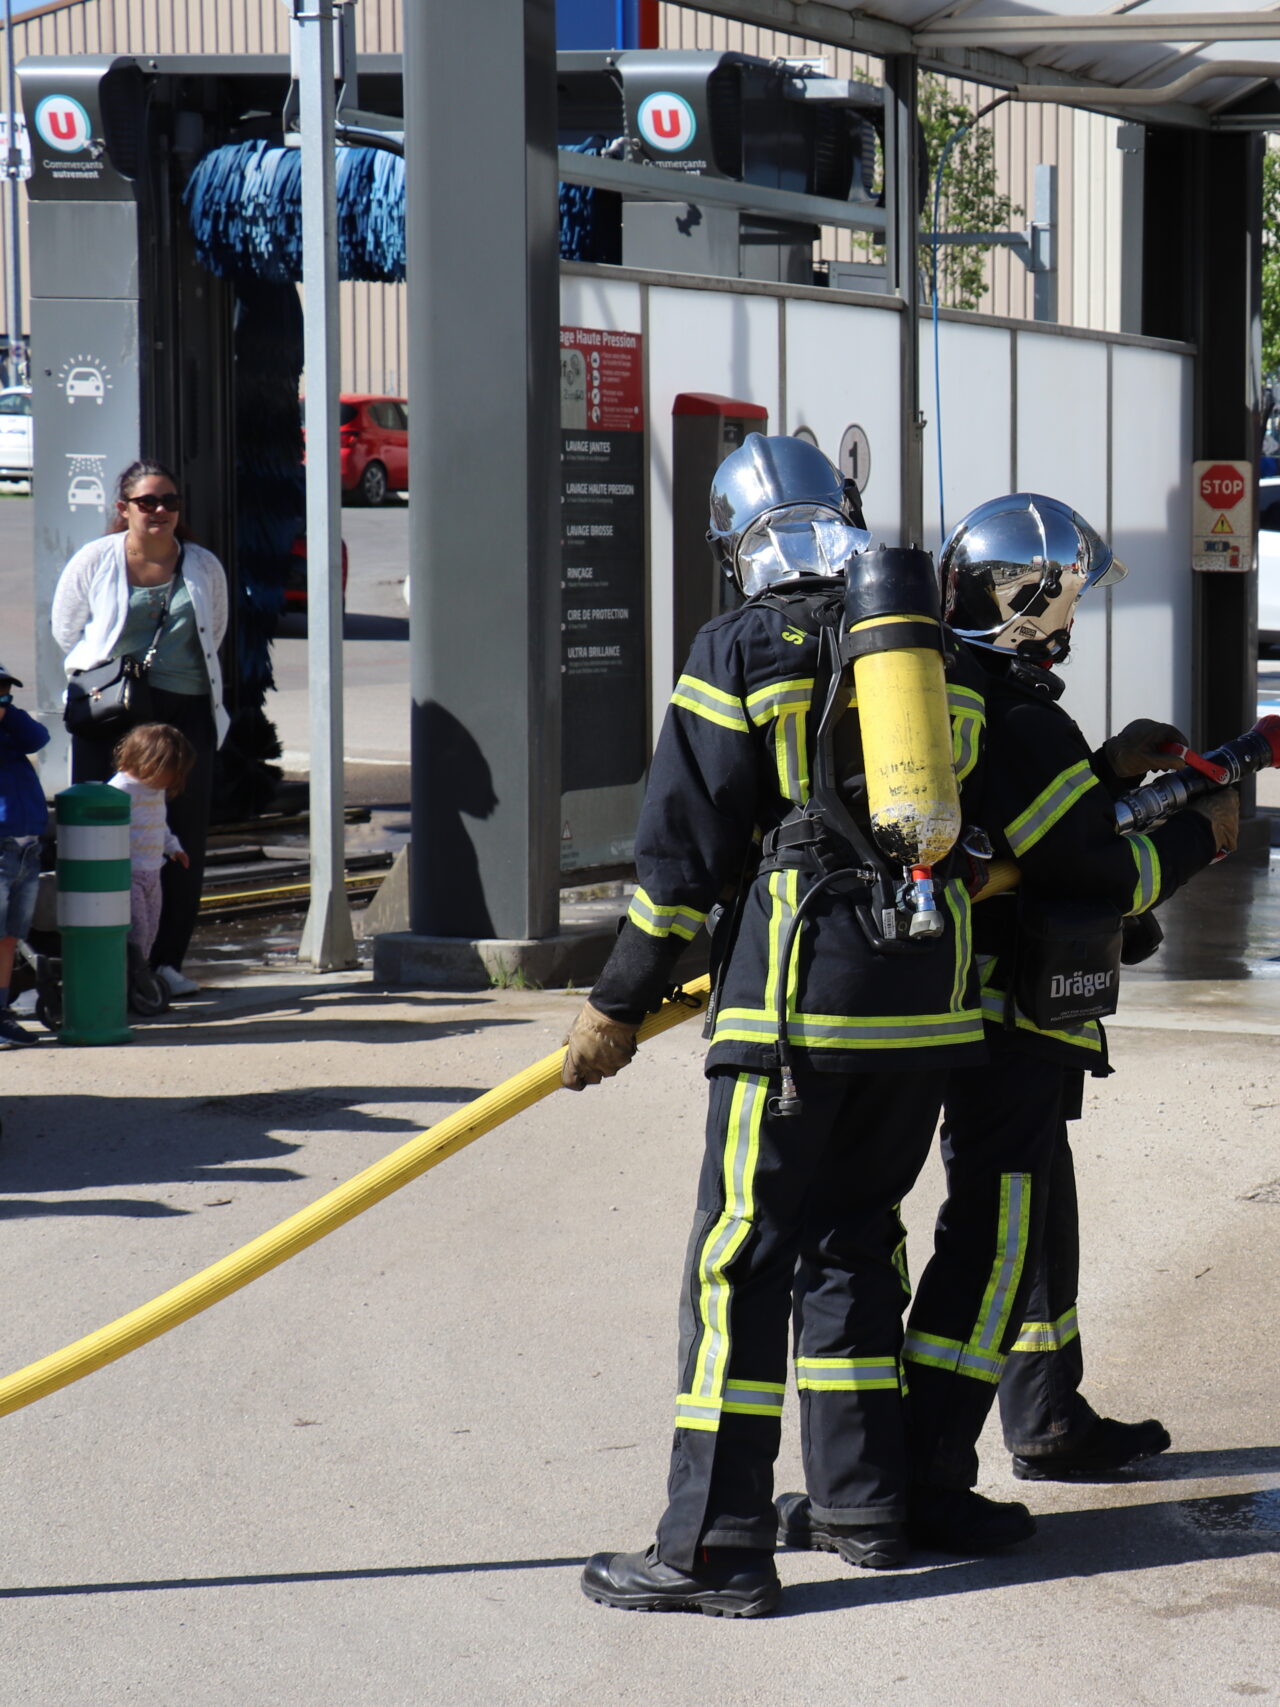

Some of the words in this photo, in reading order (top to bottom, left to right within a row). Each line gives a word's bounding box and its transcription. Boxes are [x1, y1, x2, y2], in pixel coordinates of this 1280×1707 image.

[47, 111, 77, 140] U
[651, 109, 681, 138] U
[43, 160, 104, 171] Commerçants
[642, 159, 707, 170] Cmmerçants
[52, 170, 100, 179] autrement
[576, 329, 601, 345] Haute
[602, 332, 636, 348] Pression
[565, 440, 589, 452] LAVAGE
[589, 441, 611, 454] JANTES
[848, 440, 859, 479] 1
[566, 483, 588, 494] LAVAGE
[589, 483, 607, 495] HAUTE
[608, 484, 635, 495] PRESSION
[1202, 480, 1243, 494] STOP
[566, 525, 589, 536] LAVAGE
[590, 525, 614, 536] BROSSE
[567, 567, 593, 580] RINÇAGE
[567, 609, 581, 620] CIRE
[582, 609, 591, 620] DE
[591, 608, 629, 620] PROTECTION
[567, 647, 587, 658] ULTRA
[588, 646, 620, 657] BRILLANCE
[1050, 969, 1113, 998] Dräger
